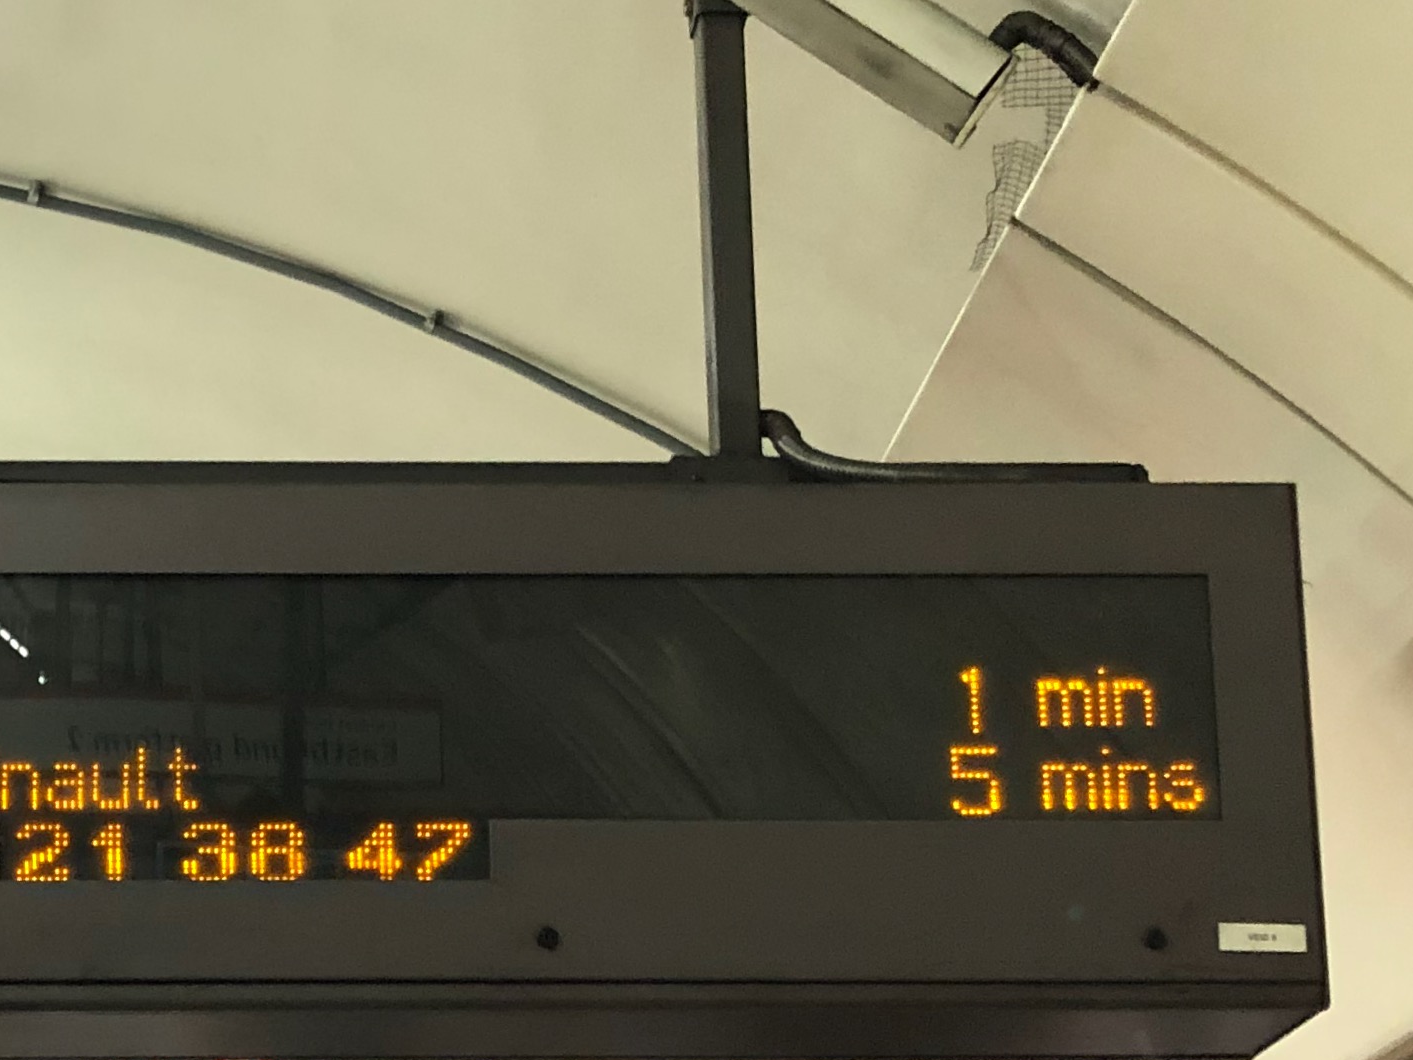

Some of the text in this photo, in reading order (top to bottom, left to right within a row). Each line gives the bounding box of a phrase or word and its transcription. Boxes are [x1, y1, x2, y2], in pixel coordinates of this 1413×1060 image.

[959, 665, 984, 735] 1
[1035, 666, 1155, 728] min
[948, 744, 1003, 817] 5
[1041, 747, 1206, 811] mins
[15, 821, 472, 882] 21 38 47
